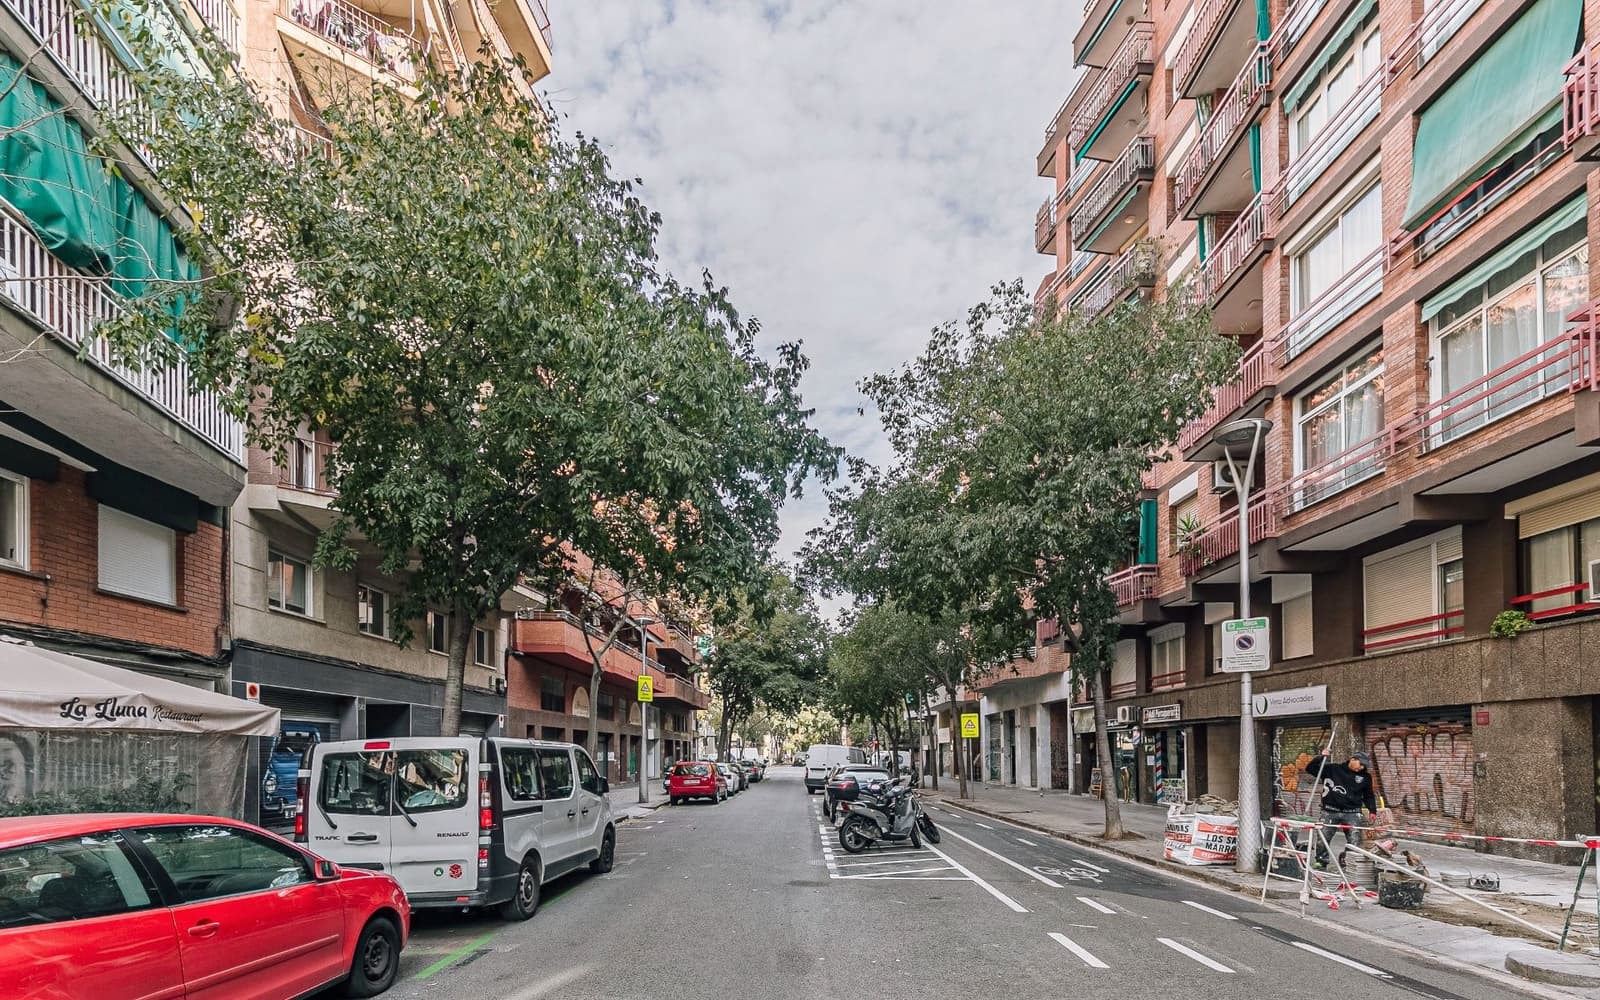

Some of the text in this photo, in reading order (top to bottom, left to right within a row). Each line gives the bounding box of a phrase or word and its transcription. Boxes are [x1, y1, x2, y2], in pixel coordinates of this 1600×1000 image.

[1283, 696, 1314, 704] Advocades
[60, 697, 204, 722] La Lluna Restaurant
[1206, 834, 1223, 843] LOS
